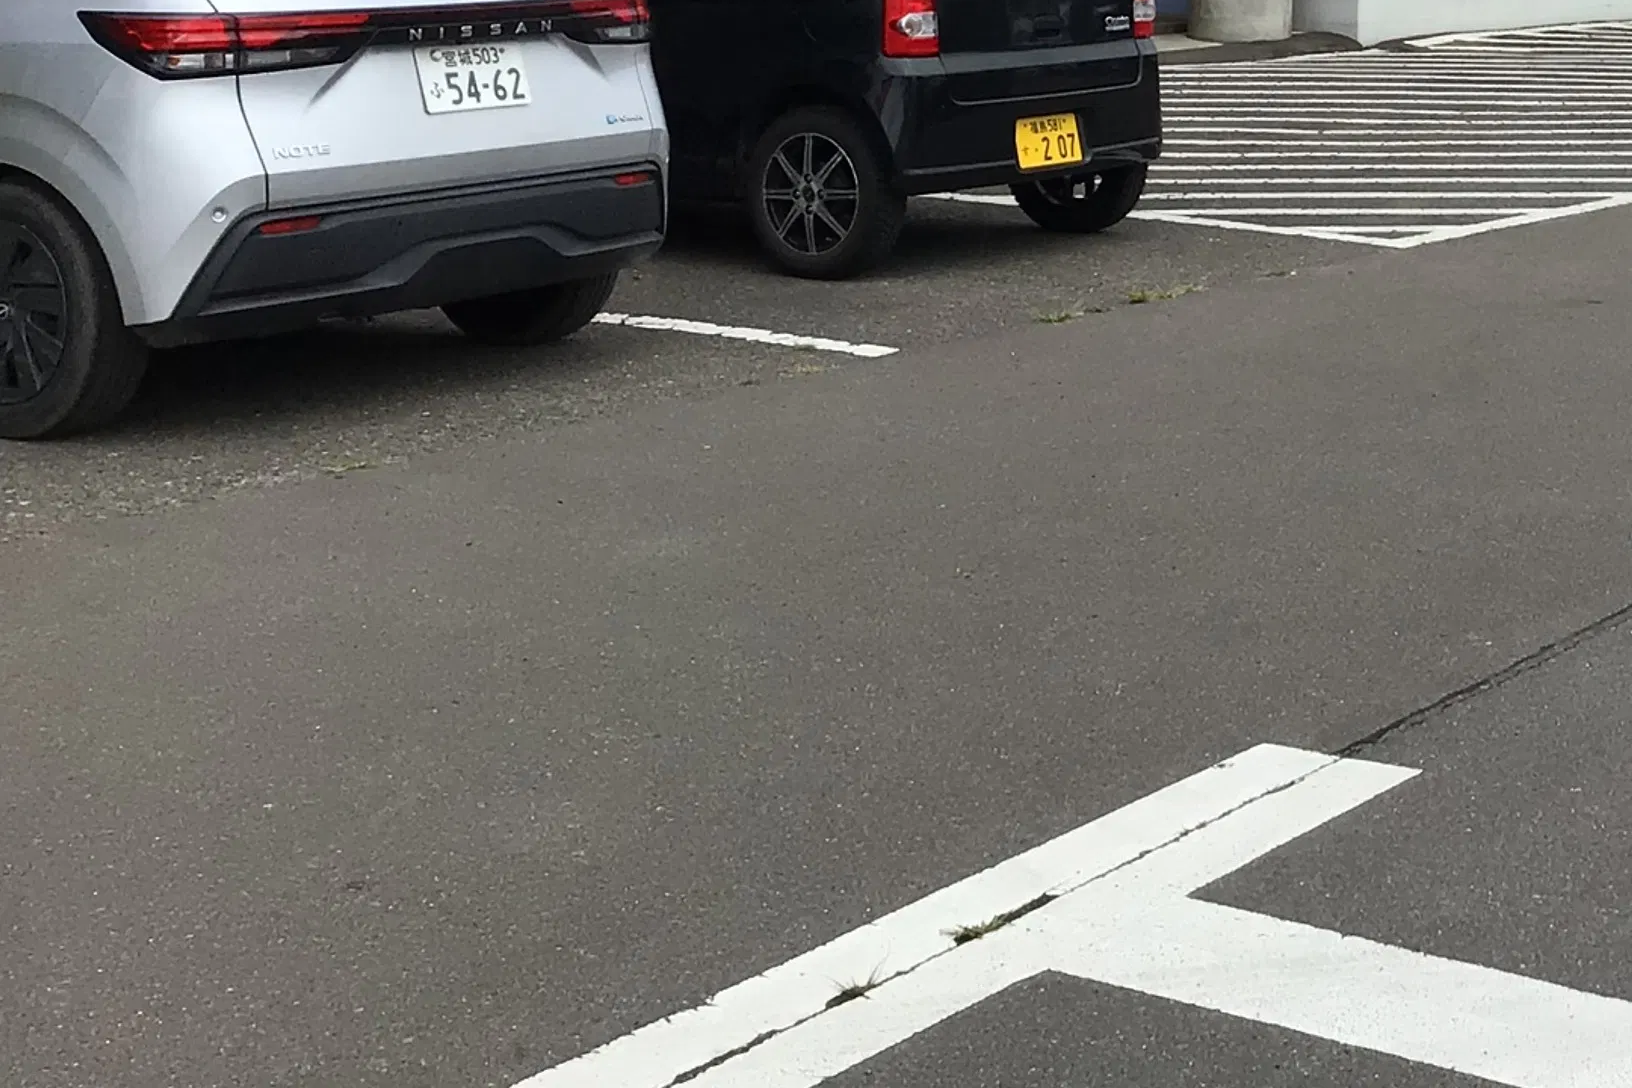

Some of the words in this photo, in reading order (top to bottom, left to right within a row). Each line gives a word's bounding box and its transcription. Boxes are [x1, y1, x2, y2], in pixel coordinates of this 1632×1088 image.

[409, 19, 552, 41] NISSAN
[444, 67, 526, 105] 54-62
[271, 143, 331, 160] NOTE
